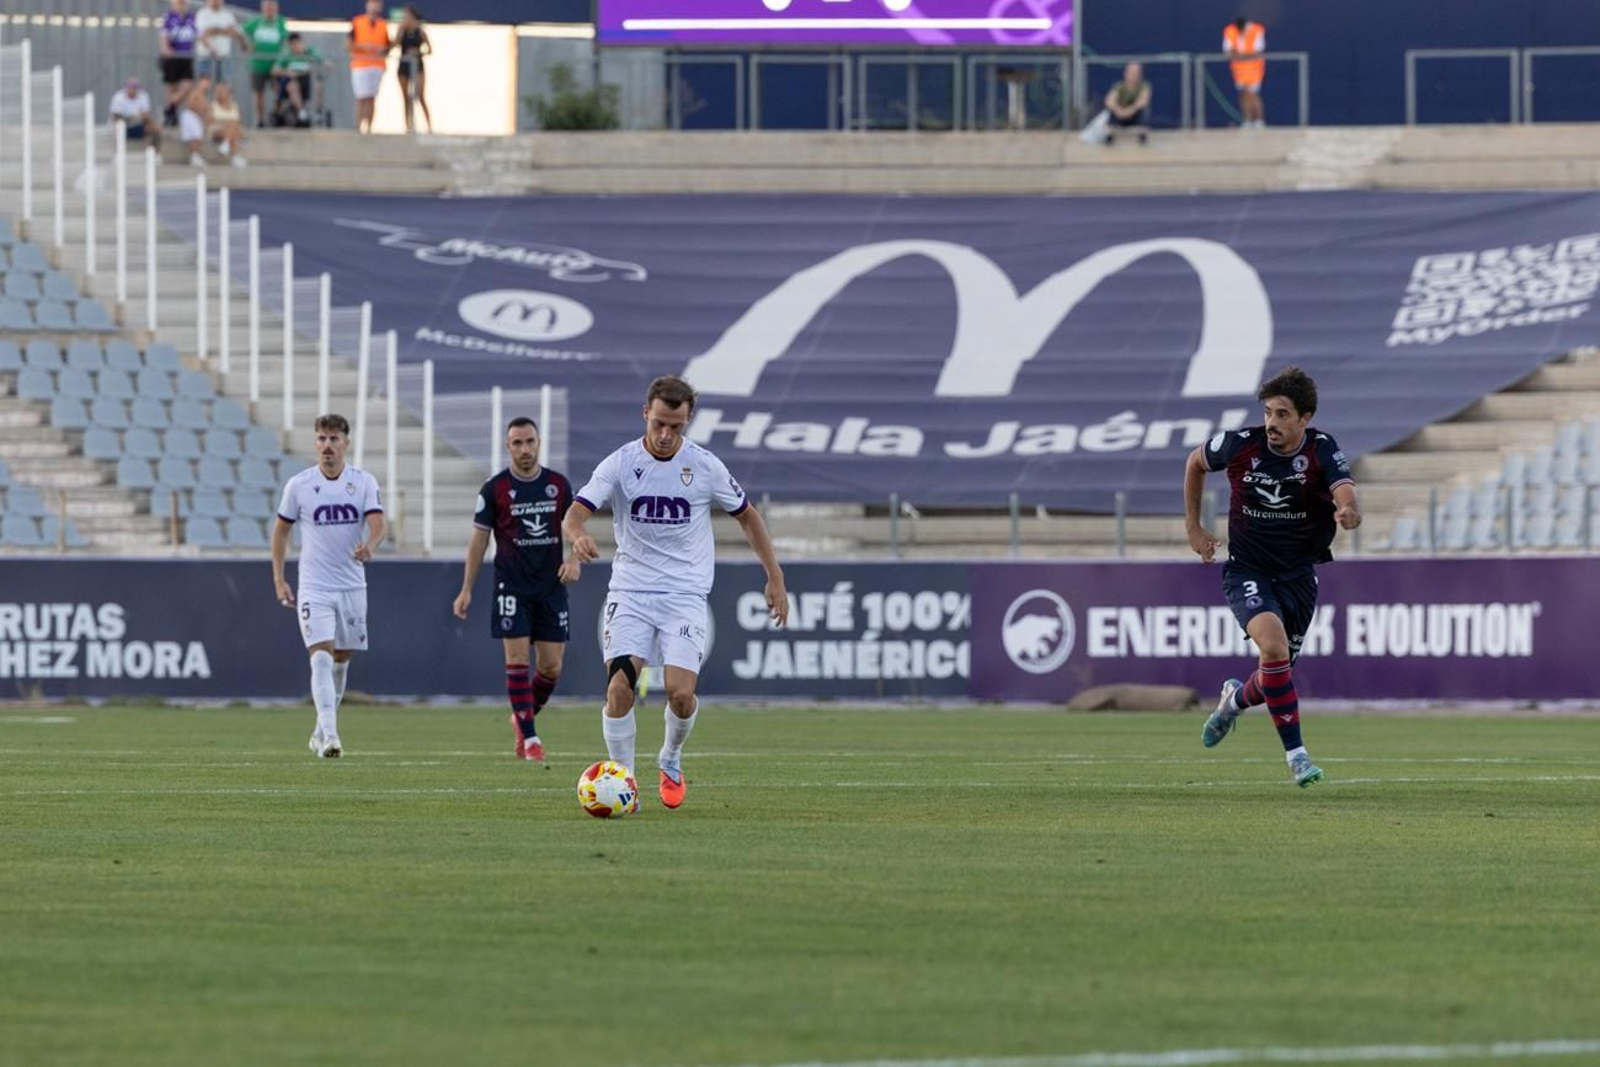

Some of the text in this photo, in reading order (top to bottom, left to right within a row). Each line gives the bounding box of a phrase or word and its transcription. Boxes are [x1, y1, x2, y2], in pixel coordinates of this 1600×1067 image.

[685, 407, 924, 457] Hala
[497, 594, 518, 616] 19
[736, 581, 855, 631] CAFÉ
[1243, 580, 1258, 597] 3
[0, 602, 127, 641] RUTAS
[301, 602, 311, 620] 5
[1087, 605, 1336, 658] ENERDK
[0, 641, 211, 679] HEZ MORA
